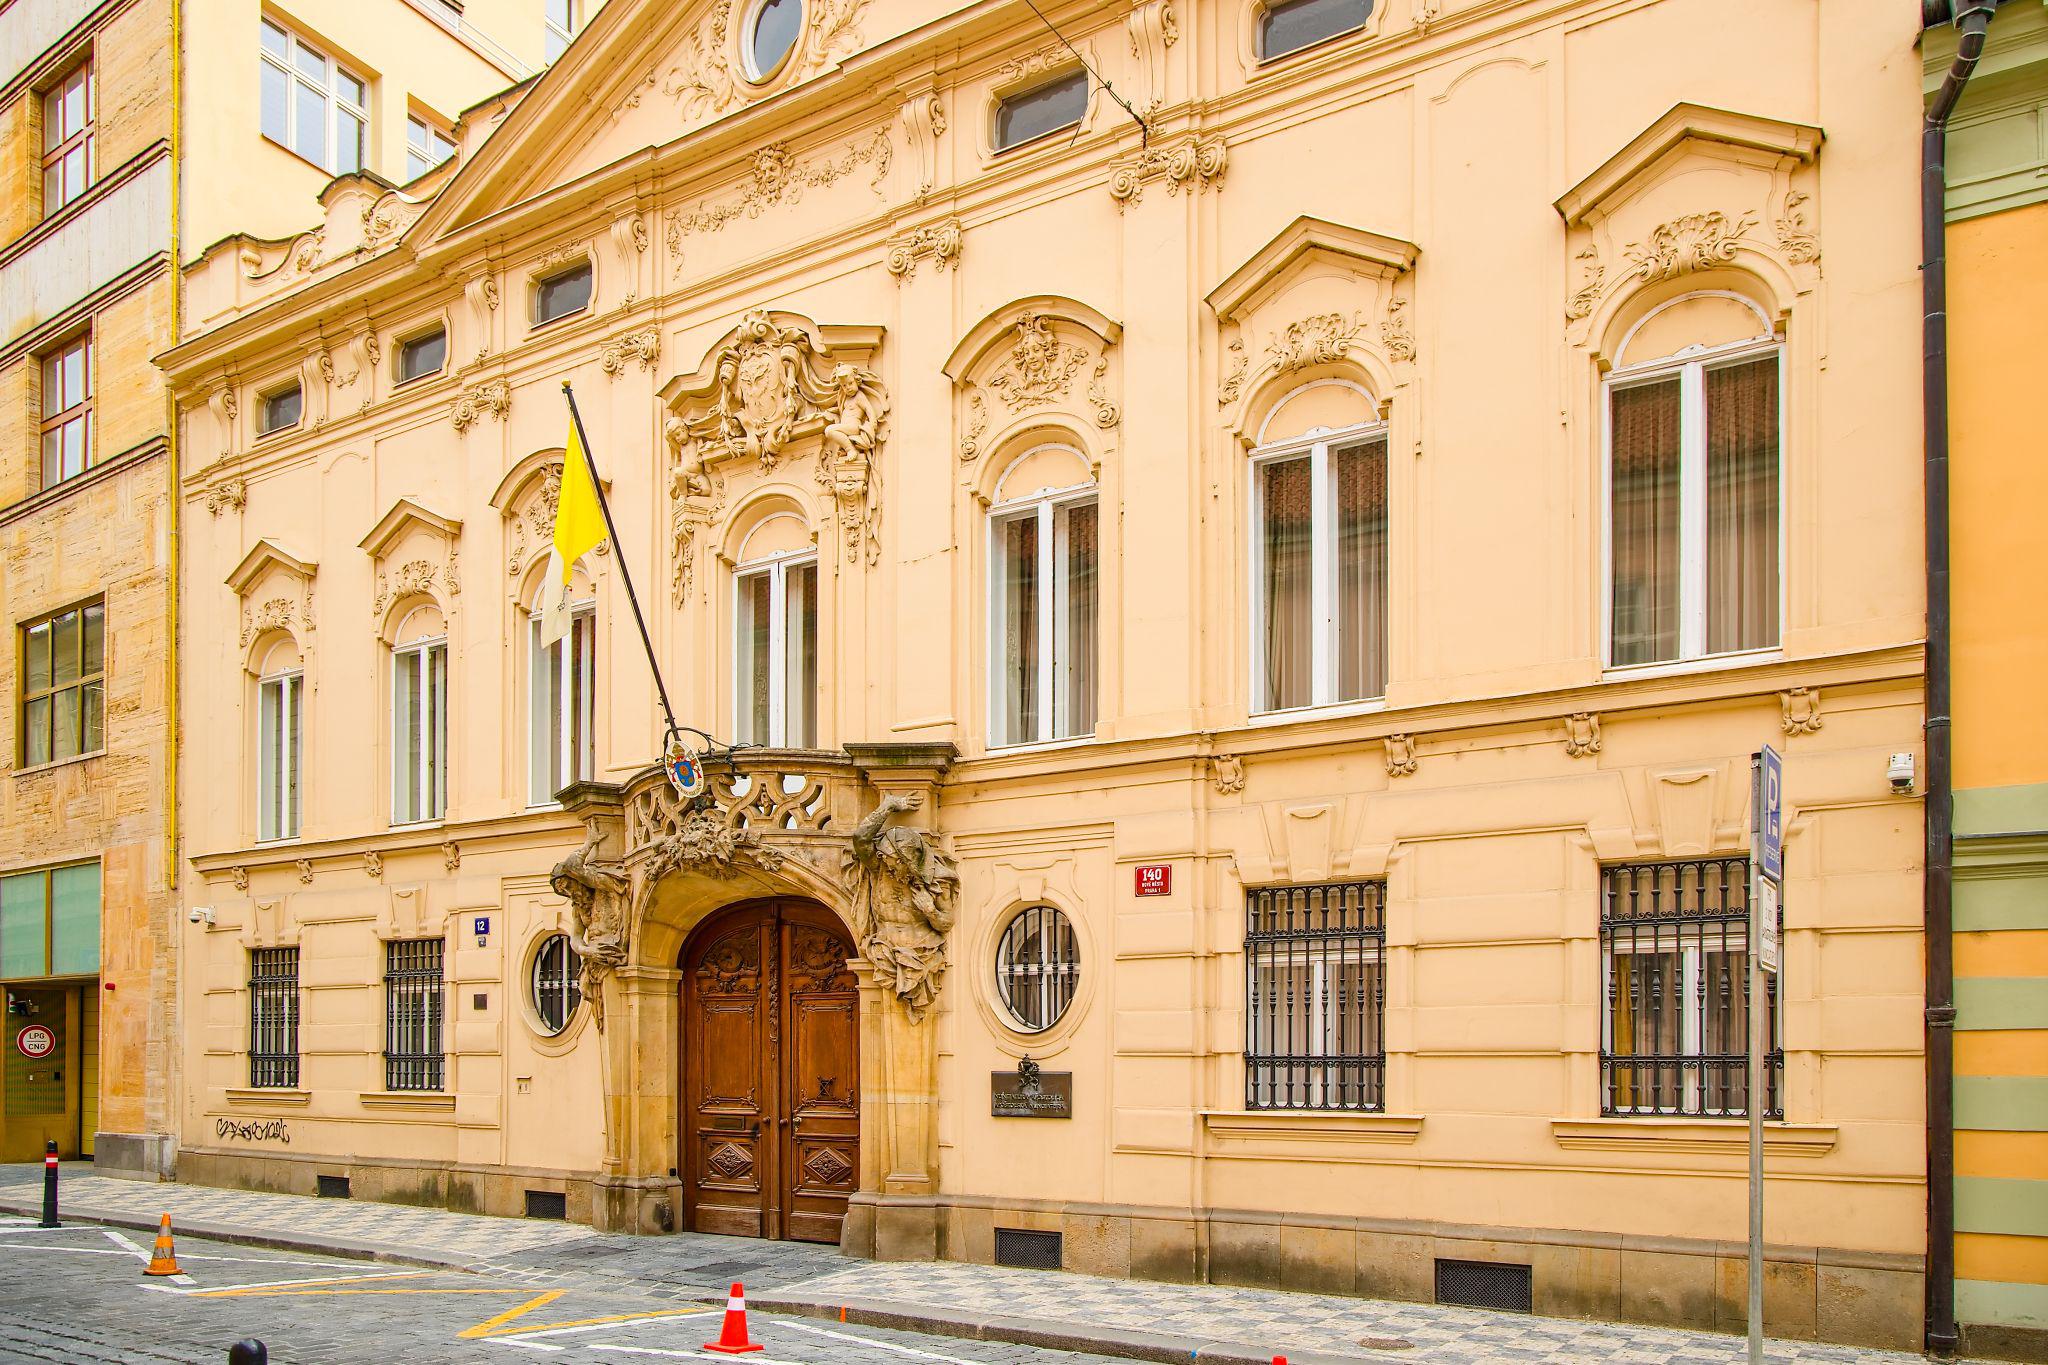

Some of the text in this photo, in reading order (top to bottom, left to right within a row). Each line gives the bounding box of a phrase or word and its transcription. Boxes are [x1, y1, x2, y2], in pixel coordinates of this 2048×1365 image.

[1768, 766, 1778, 835] P
[1142, 868, 1162, 881] 140
[477, 920, 485, 931] 12
[29, 1032, 45, 1040] LPG
